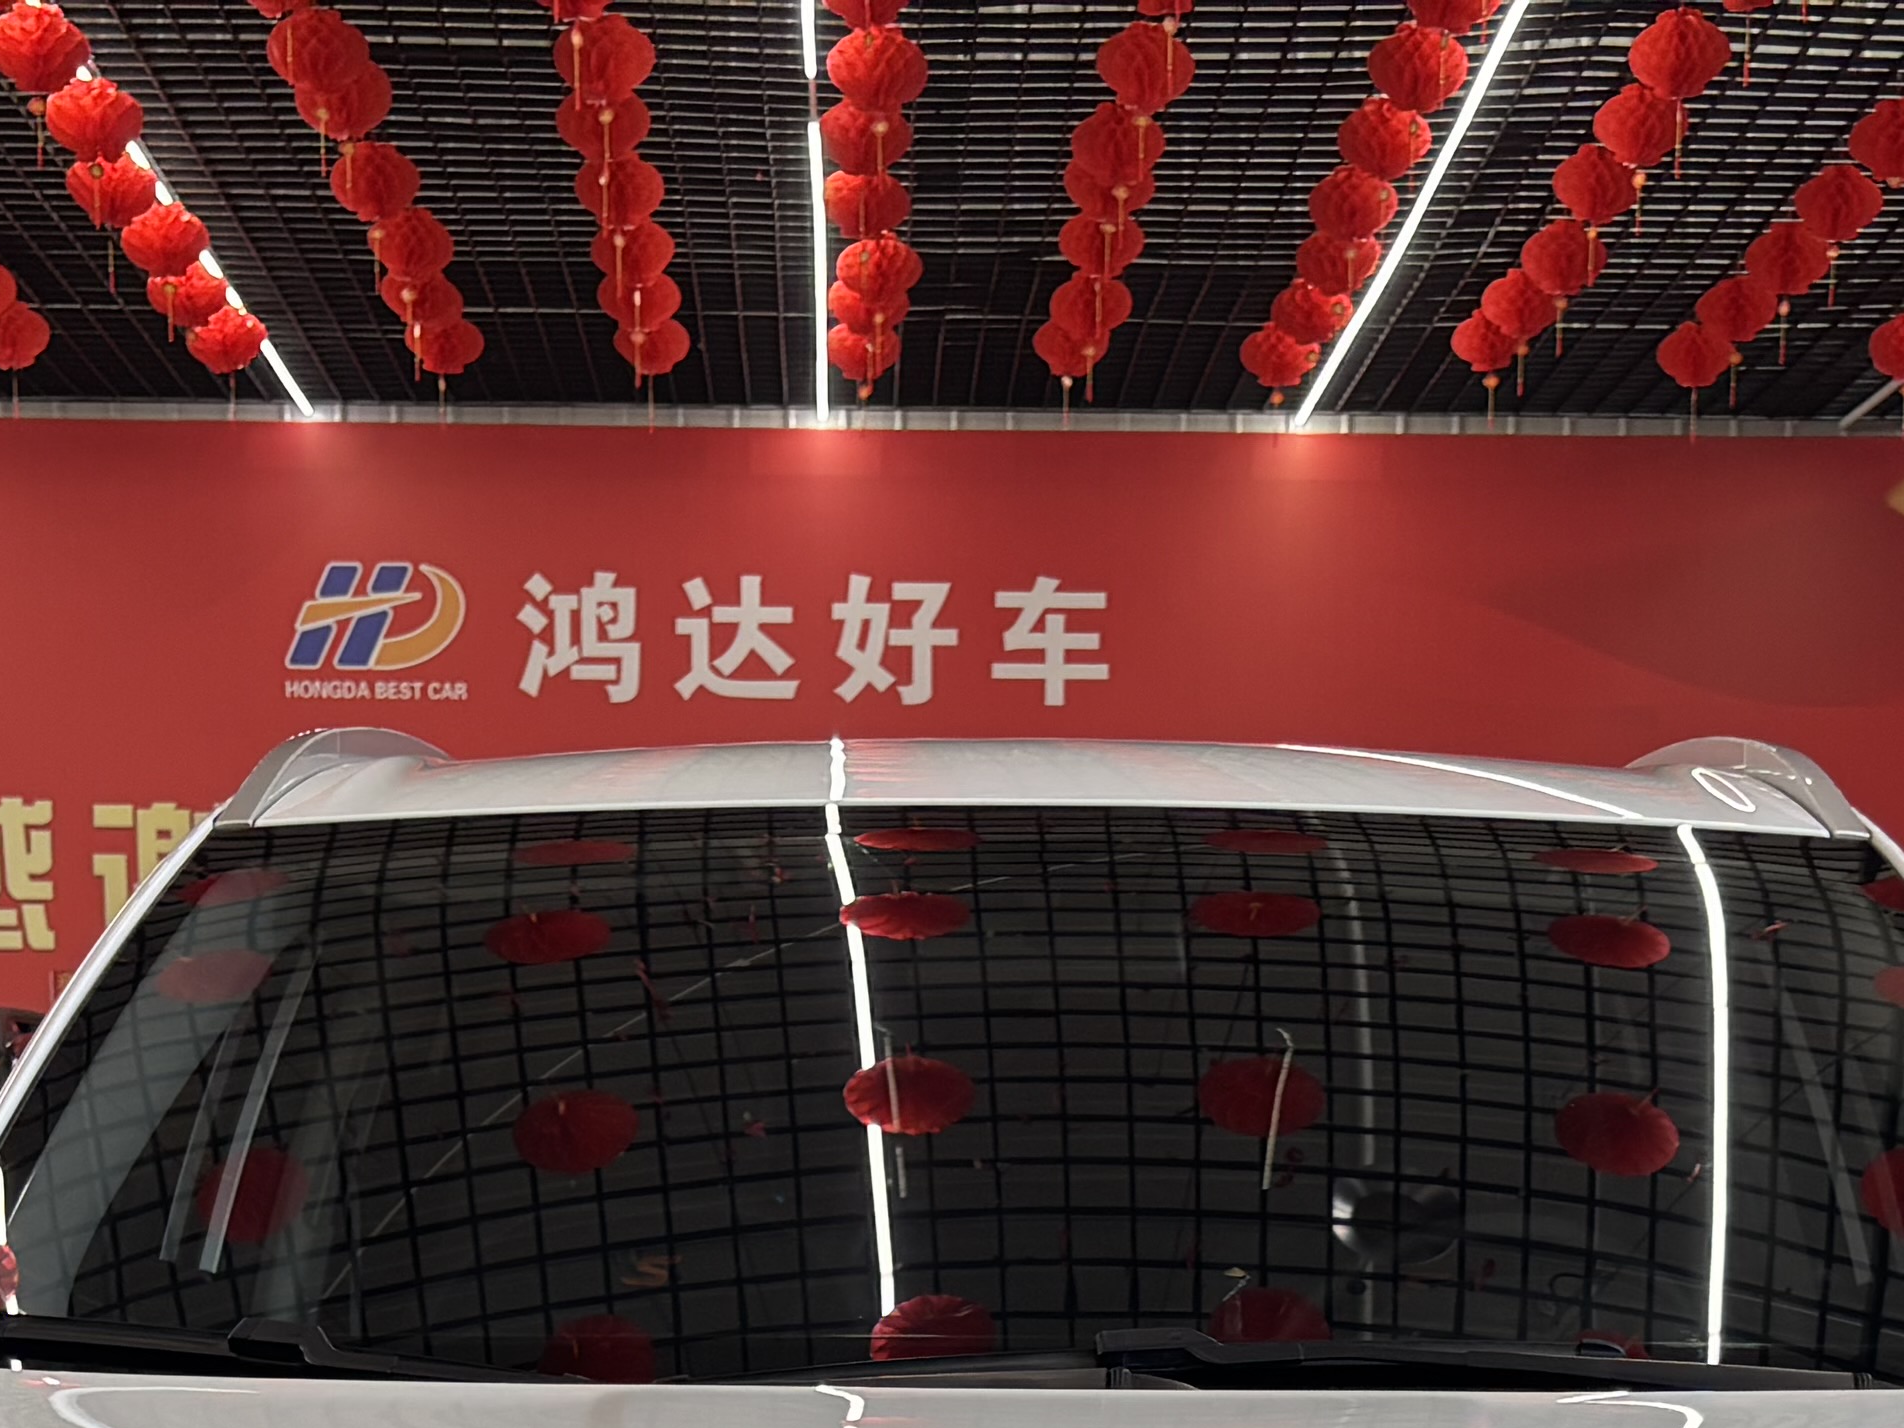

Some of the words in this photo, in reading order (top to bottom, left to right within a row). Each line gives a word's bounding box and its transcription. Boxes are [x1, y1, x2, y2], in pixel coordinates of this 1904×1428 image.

[517, 572, 1111, 705] 鸿达好车
[284, 680, 371, 699] HONGDA
[374, 680, 423, 700] BEST
[427, 681, 468, 700] CAR
